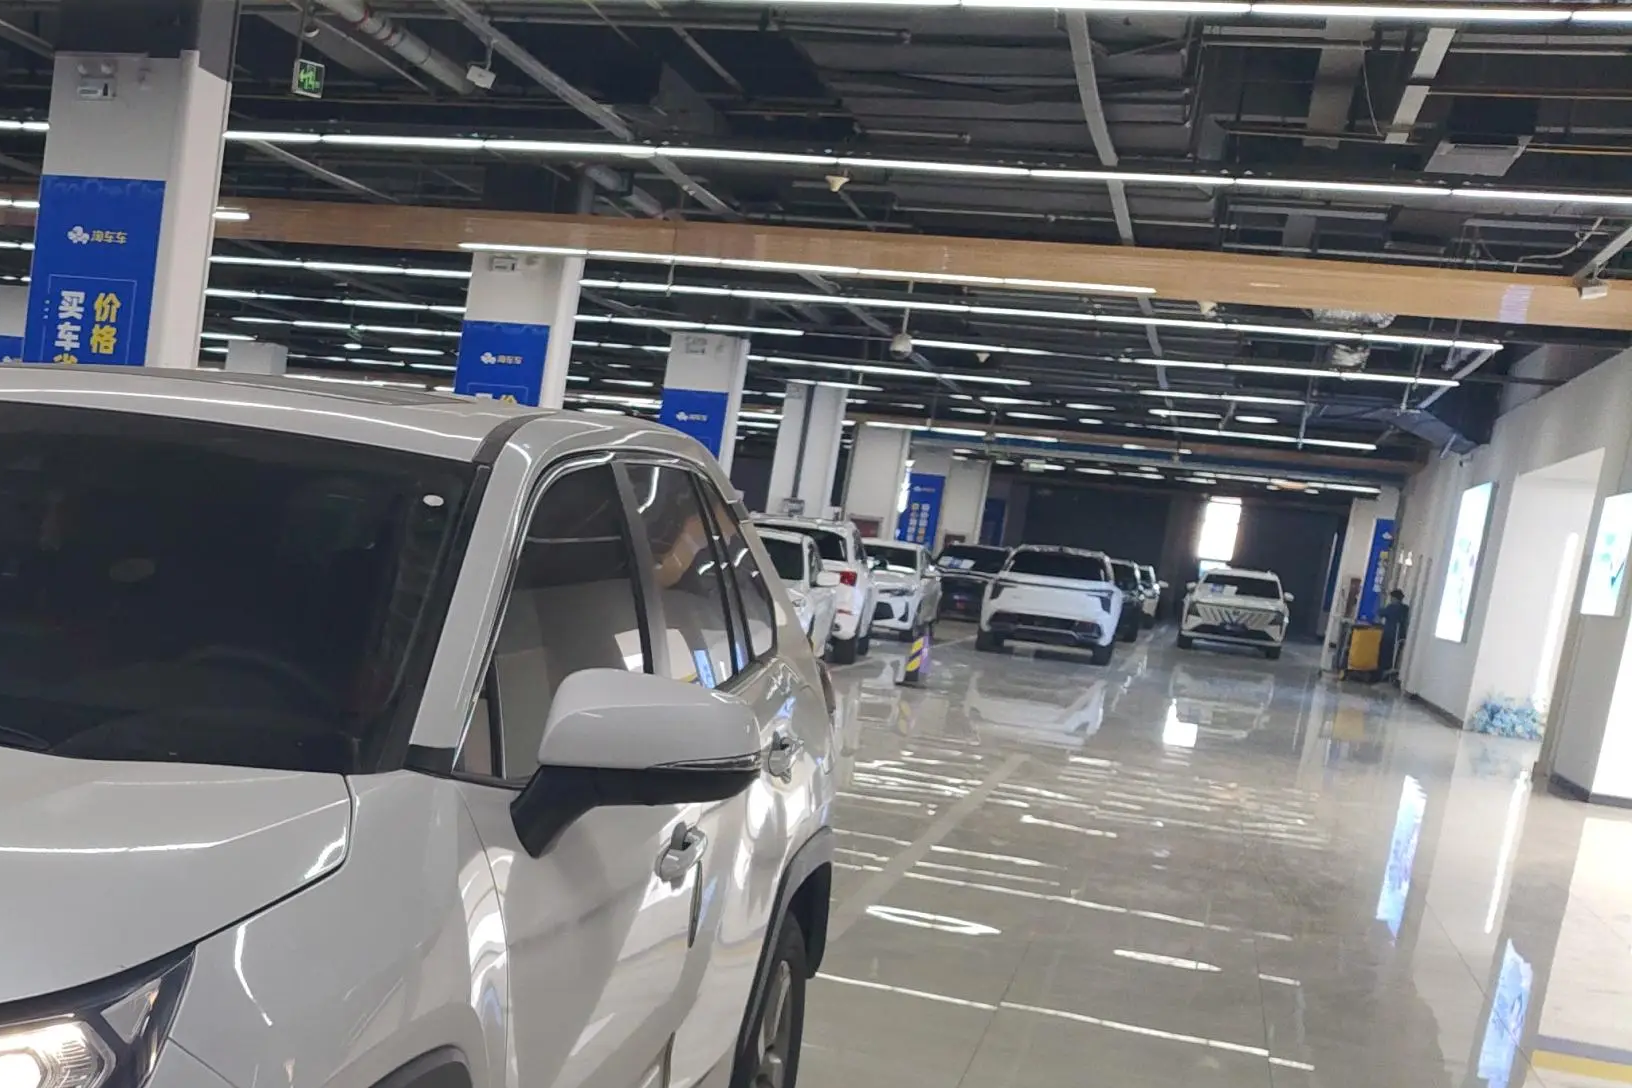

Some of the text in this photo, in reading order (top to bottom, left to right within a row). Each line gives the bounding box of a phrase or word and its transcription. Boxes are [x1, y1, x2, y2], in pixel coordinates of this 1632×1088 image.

[91, 229, 128, 244] 淘车车
[89, 292, 121, 355] 价格
